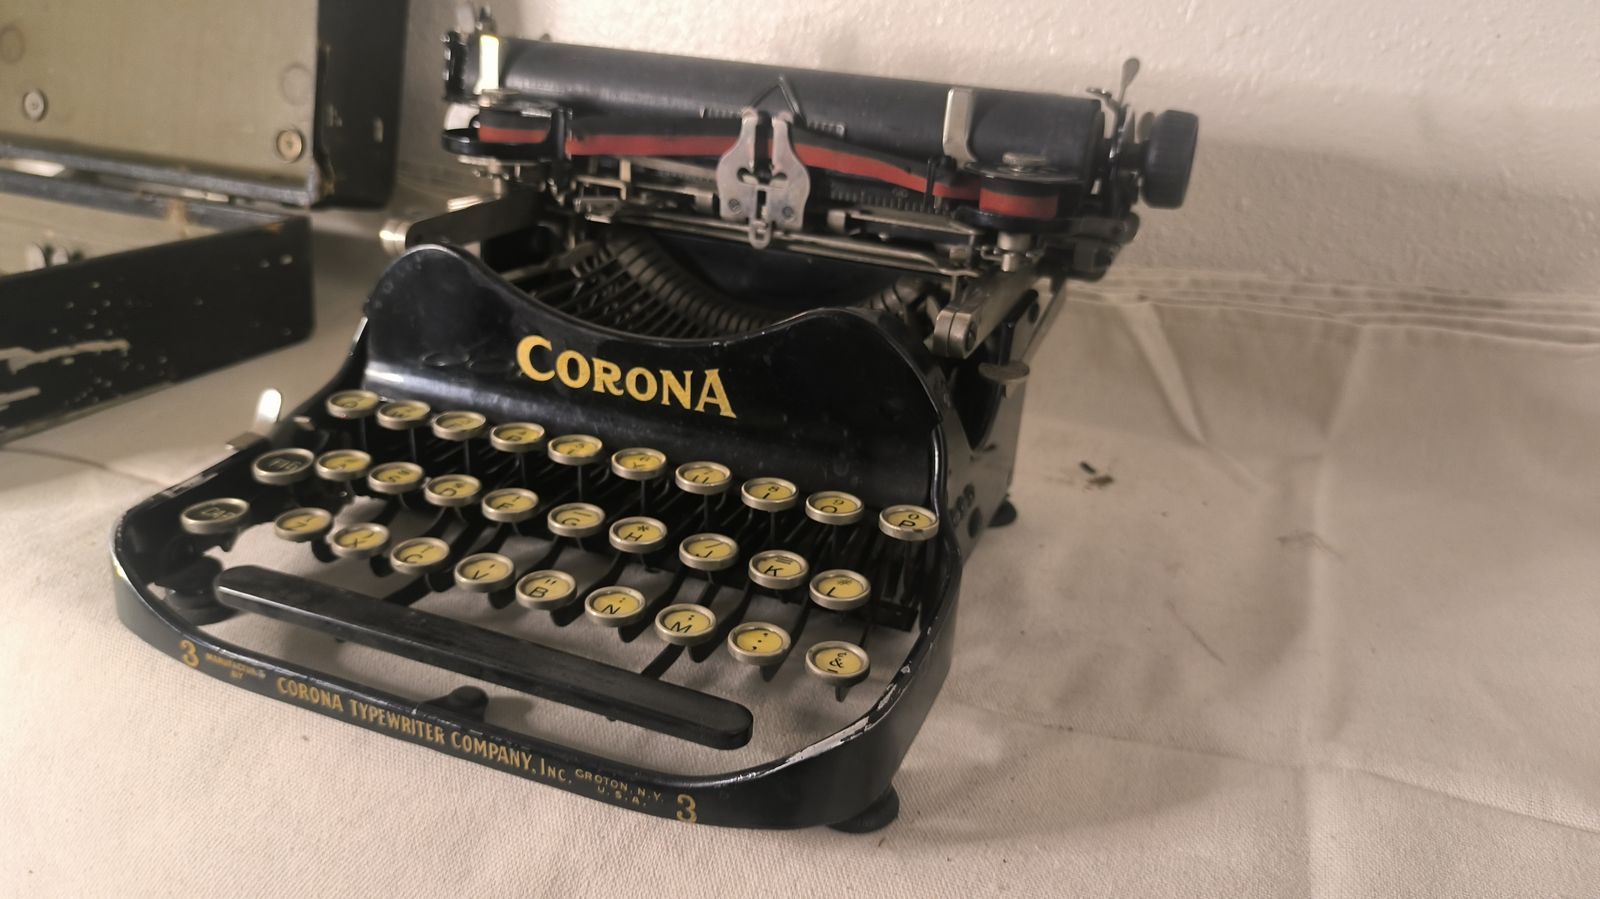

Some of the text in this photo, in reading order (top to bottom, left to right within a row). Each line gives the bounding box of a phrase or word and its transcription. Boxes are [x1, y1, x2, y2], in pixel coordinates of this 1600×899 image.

[516, 335, 737, 419] CORONA
[623, 531, 643, 542] H
[763, 564, 784, 577] K
[527, 586, 549, 598] B
[601, 603, 622, 615] N
[670, 620, 693, 634] M
[178, 639, 200, 670] 3
[276, 676, 343, 713] CORONA
[350, 698, 445, 746] TYPEWRITER
[676, 793, 698, 823] 3
